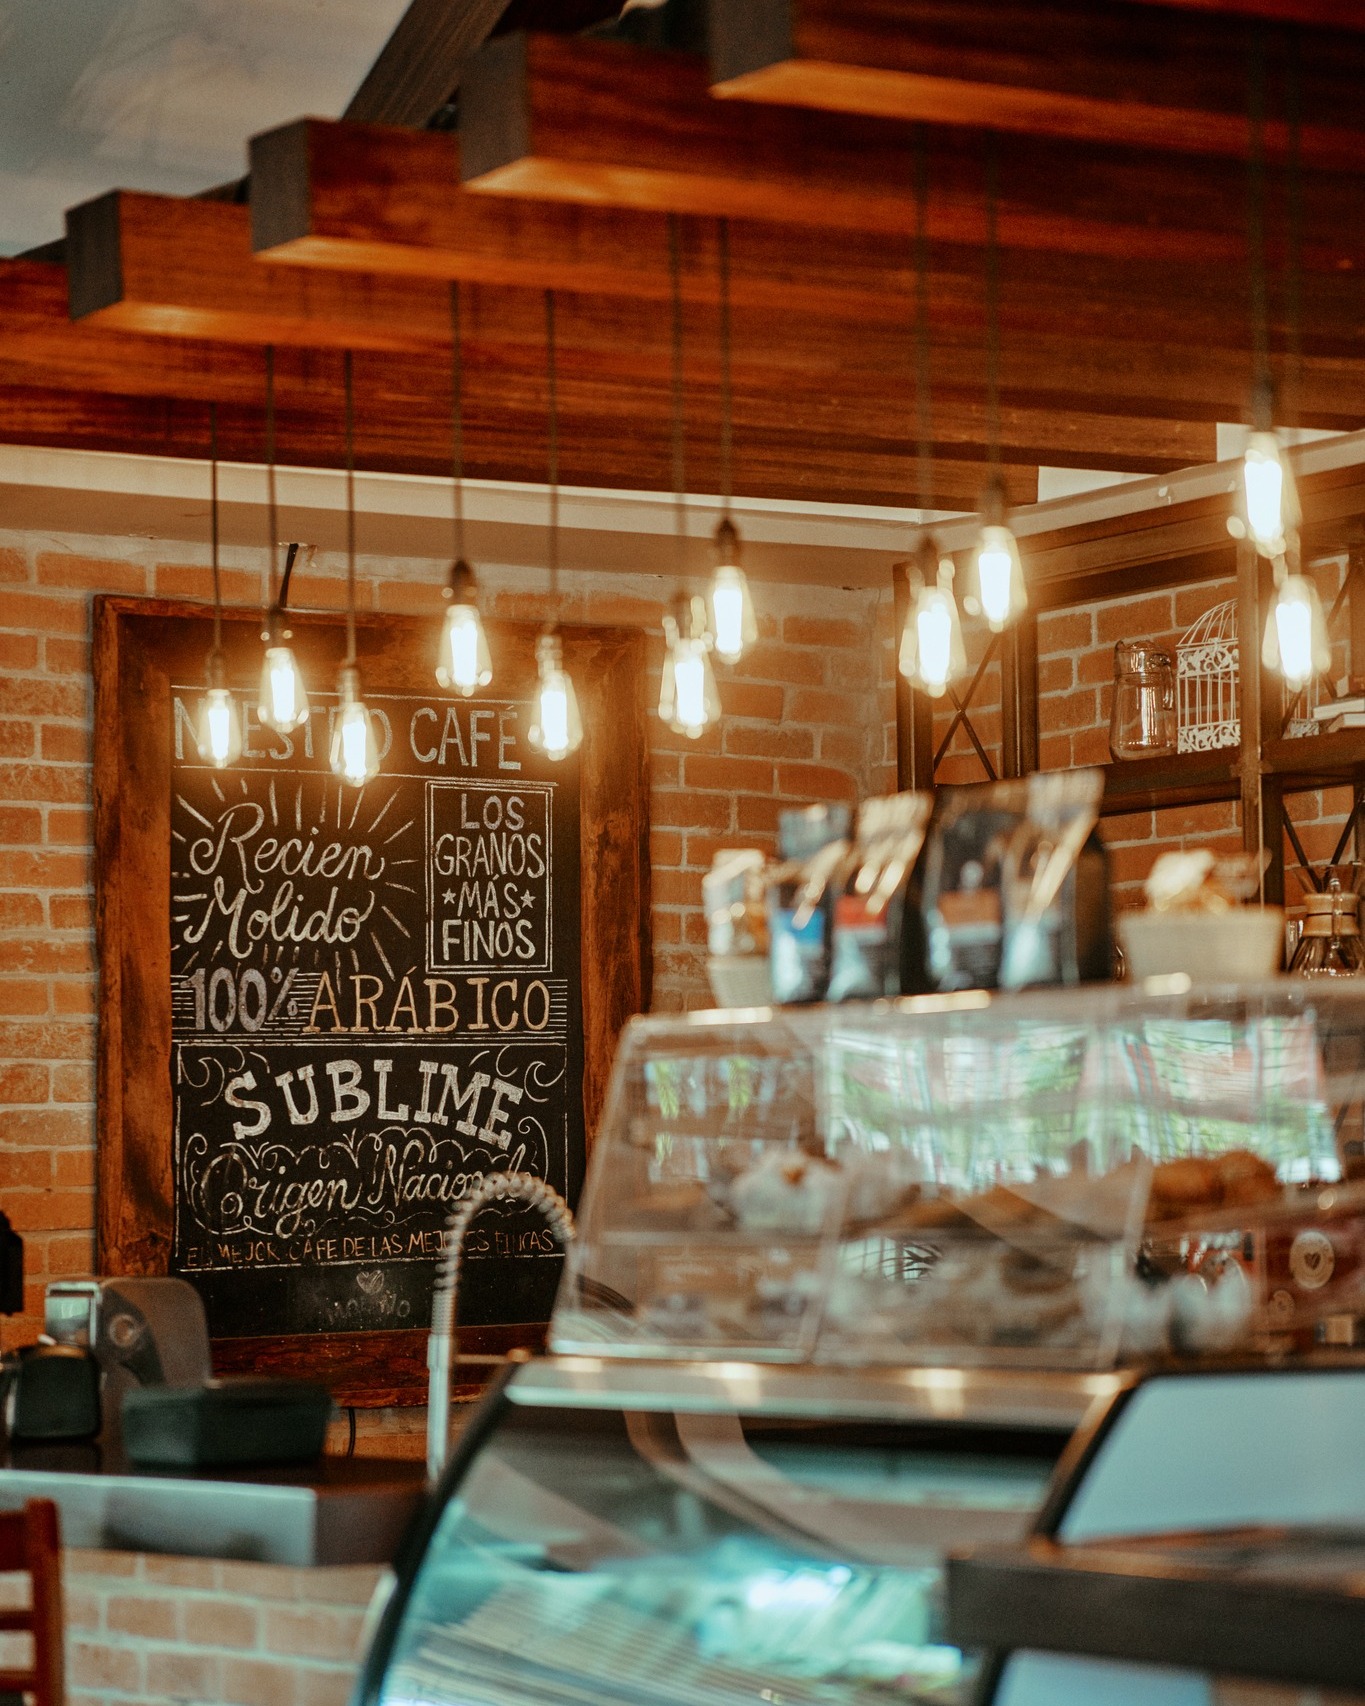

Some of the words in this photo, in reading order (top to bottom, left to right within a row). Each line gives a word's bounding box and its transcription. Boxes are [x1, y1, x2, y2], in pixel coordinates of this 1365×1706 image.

[174, 696, 393, 761] NESTO
[410, 704, 522, 771] CAFÉ
[460, 793, 525, 831] LOS
[189, 802, 386, 894] Recien
[434, 832, 546, 878] GRANOS
[183, 875, 375, 959] Molido
[456, 875, 521, 919] MÁS
[442, 918, 537, 962] FINOS
[179, 966, 300, 1033] 100%
[302, 965, 552, 1034] ARÁBICO
[224, 1058, 524, 1150] SUBLIME
[199, 1152, 364, 1239] Origen
[366, 1138, 531, 1207] Nacionl
[343, 1236, 366, 1258] DE
[370, 1233, 403, 1258] LAS
